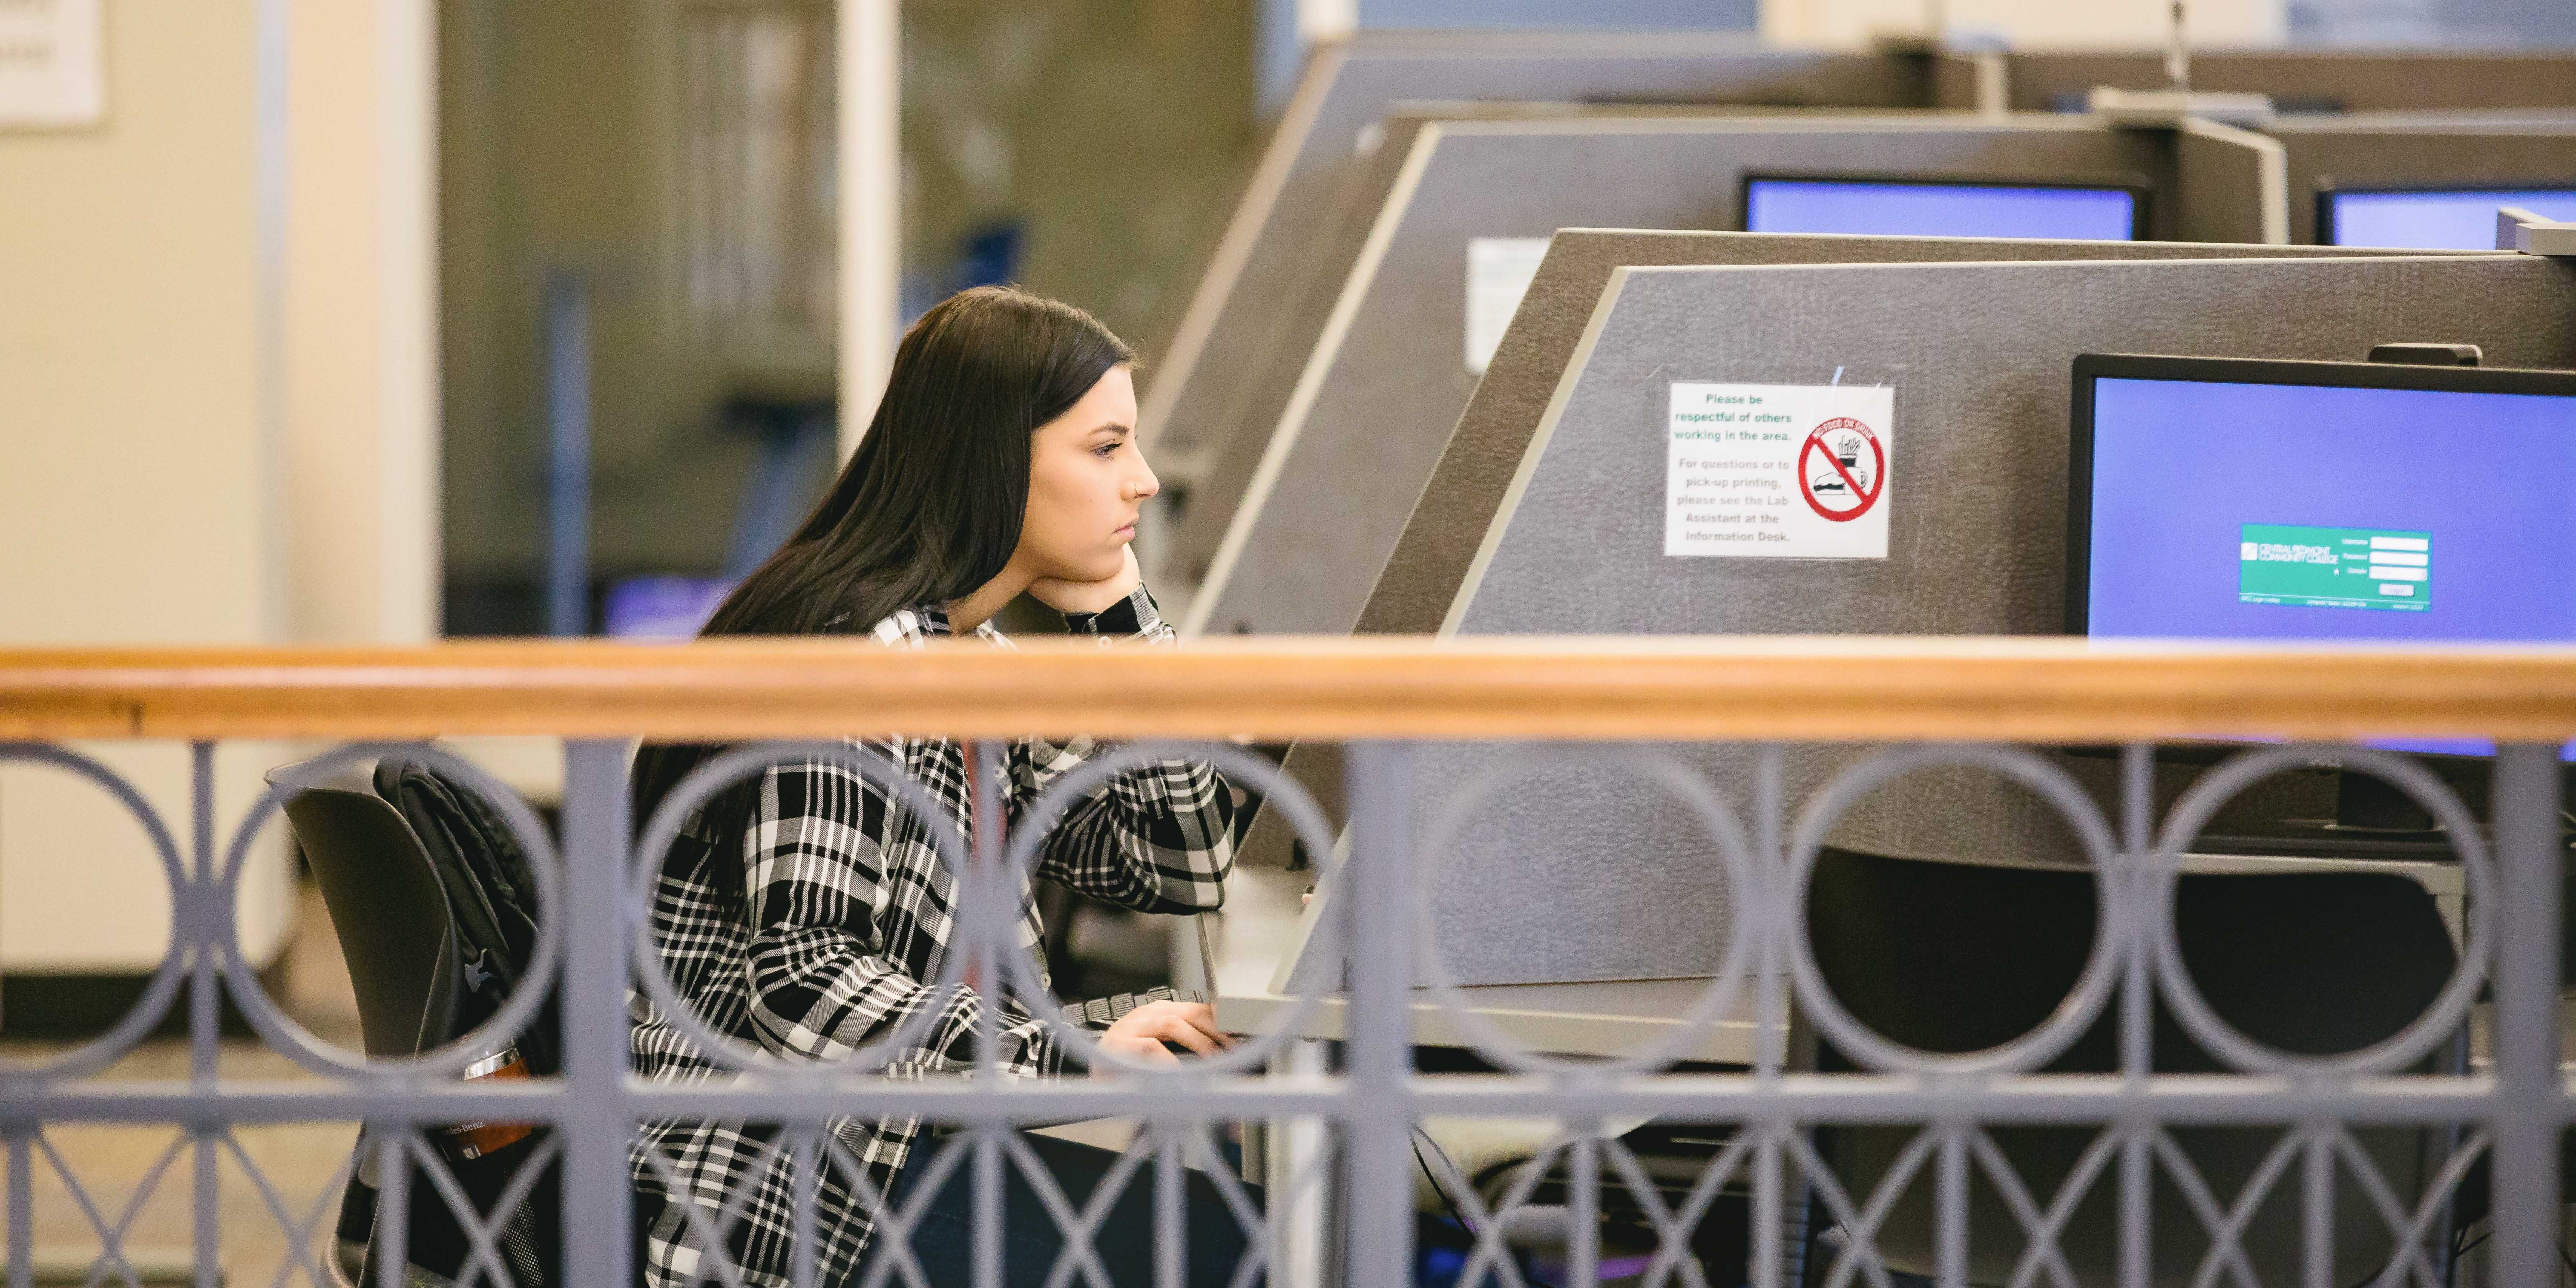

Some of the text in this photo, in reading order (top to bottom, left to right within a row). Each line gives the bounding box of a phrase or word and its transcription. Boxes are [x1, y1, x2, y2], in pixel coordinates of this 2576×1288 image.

[1706, 394, 1763, 404] Please be
[1675, 412, 1792, 423] respectful of others
[1812, 419, 1875, 440] NO FOOD OR DRINK
[1674, 429, 1792, 442] working in the area.
[1678, 458, 1790, 471] For questions or to
[1686, 477, 1782, 490] pick-up printing,
[1677, 495, 1789, 506] please see the Lab
[1686, 513, 1779, 524] Assistant at the
[1758, 531, 1791, 542] Desk.
[2260, 544, 2291, 553] CENTRAL
[2259, 552, 2339, 565] COMMUNITY COLLEGE
